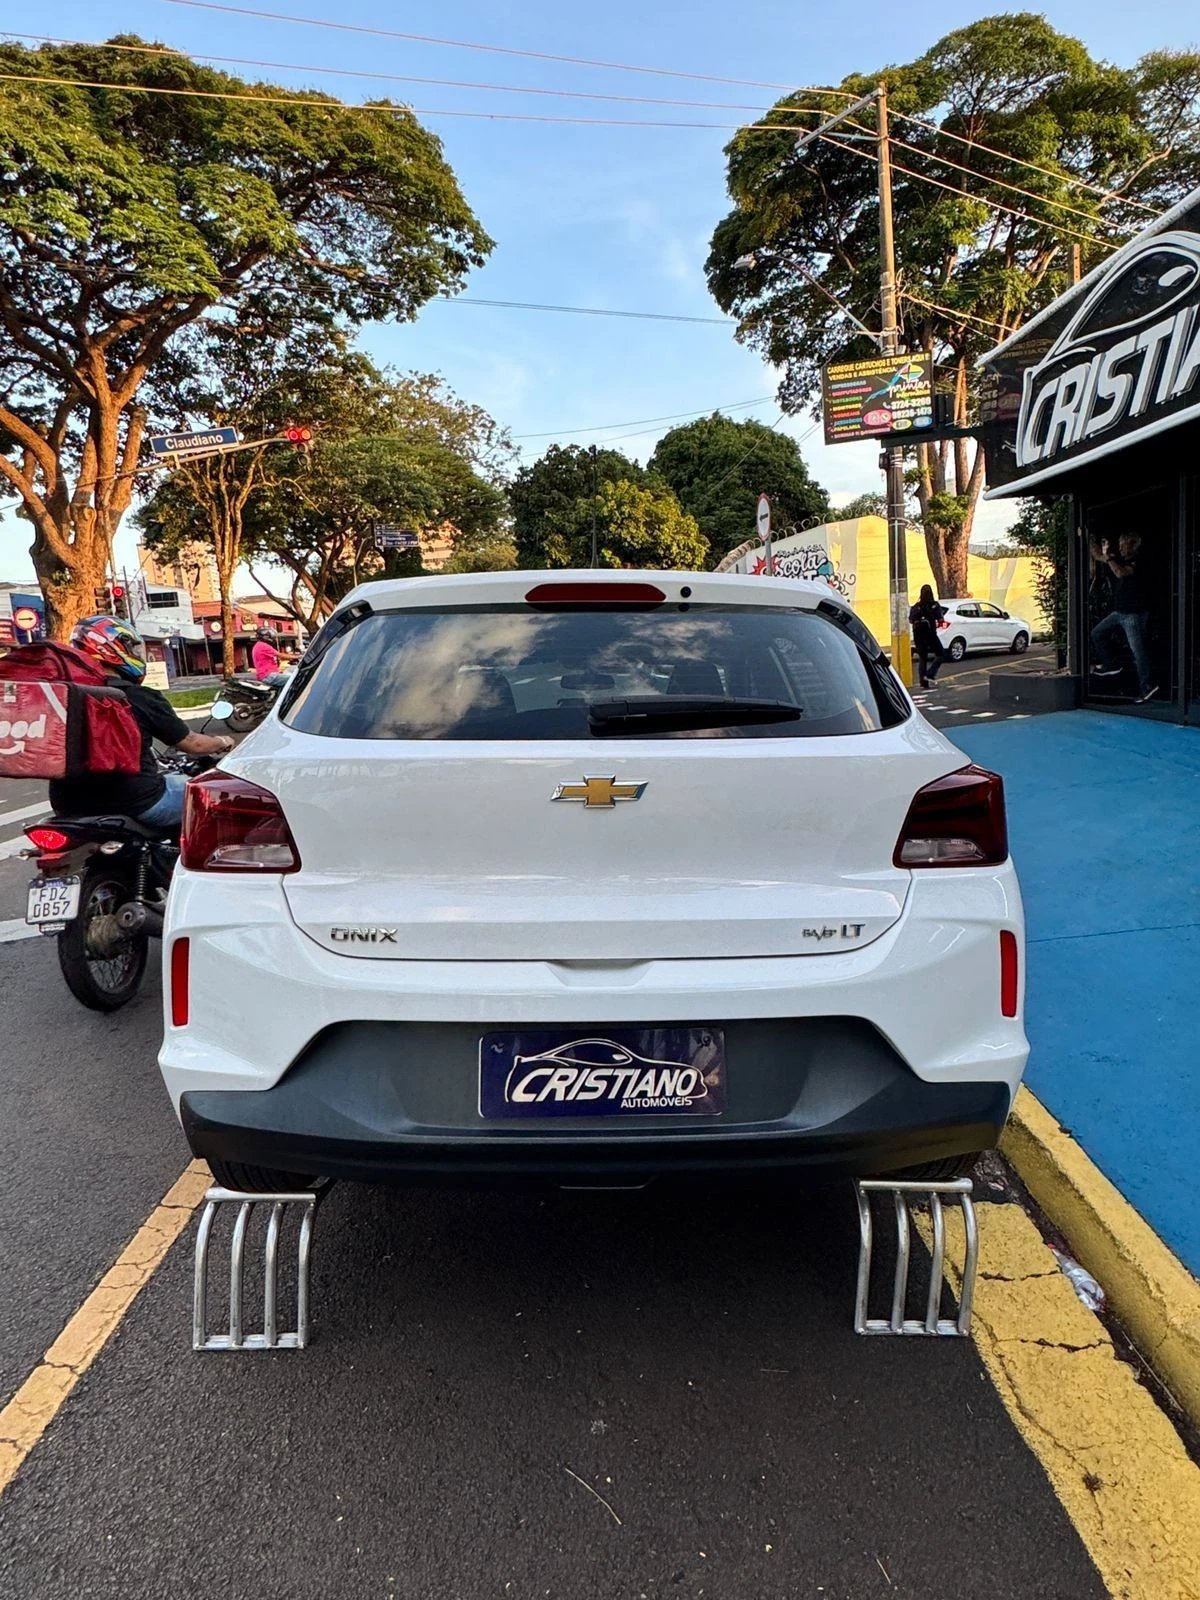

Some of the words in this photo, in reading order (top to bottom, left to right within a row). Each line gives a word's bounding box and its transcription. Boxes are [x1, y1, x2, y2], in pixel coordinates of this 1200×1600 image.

[829, 373, 852, 381] VENDAS
[165, 434, 223, 449] Claudiano
[40, 886, 68, 902] FDZ
[330, 927, 398, 943] ONIX
[841, 922, 866, 938] LT
[512, 1068, 697, 1102] CRISTIANO
